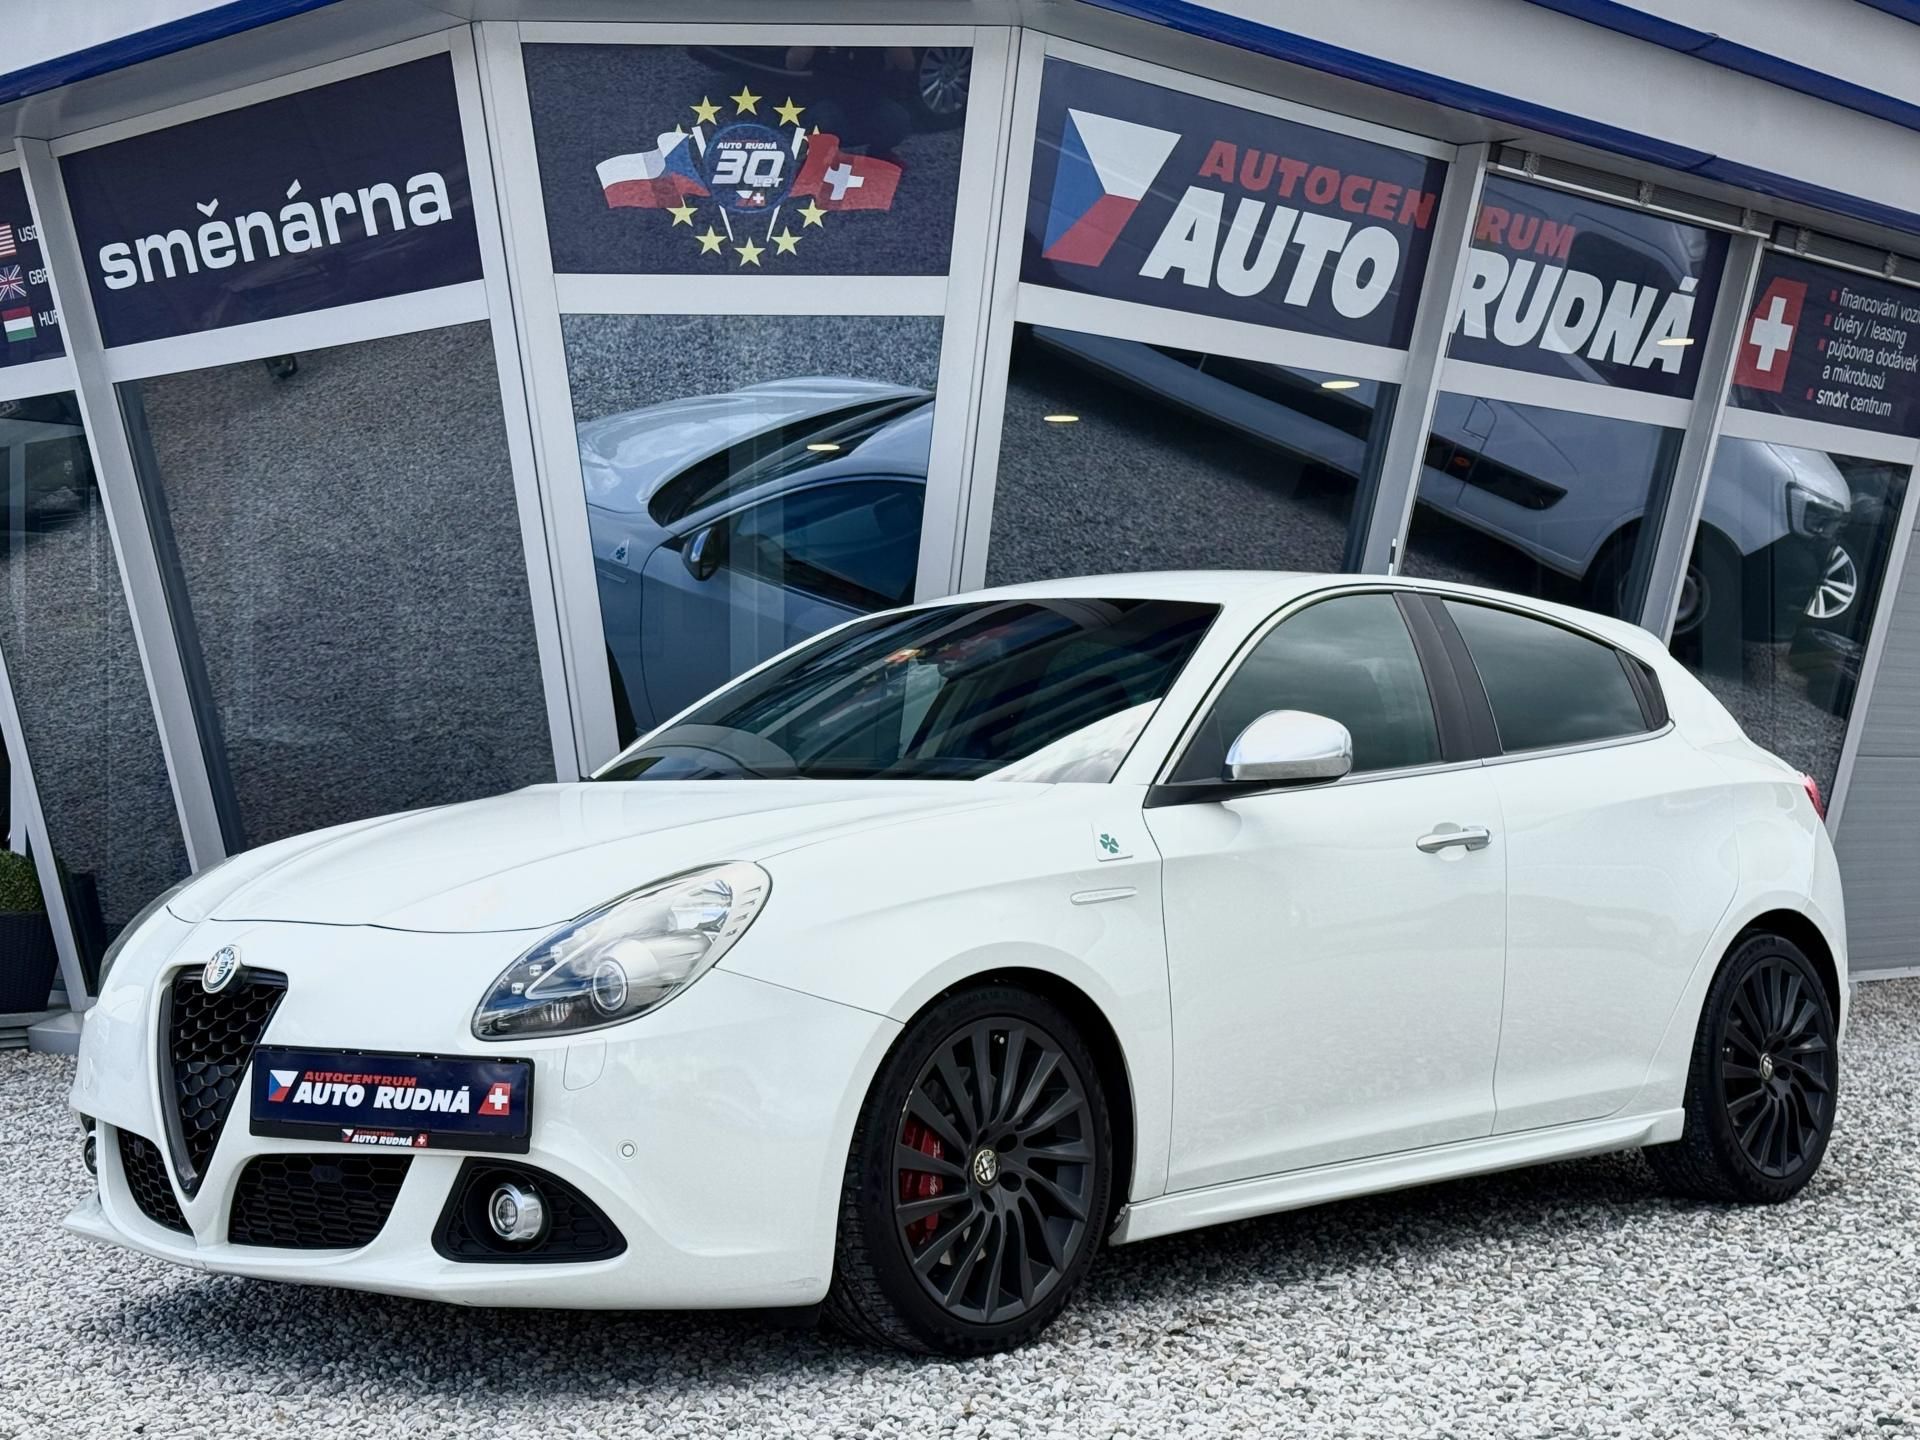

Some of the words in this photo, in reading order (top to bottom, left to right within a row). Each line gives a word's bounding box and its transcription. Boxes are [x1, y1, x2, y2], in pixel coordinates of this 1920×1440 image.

[717, 142, 742, 150] AUTO
[712, 150, 785, 185] 30
[99, 171, 453, 290] směnárna
[1138, 185, 1400, 319] AUTO
[1450, 247, 1699, 374] RUDNÁ
[1839, 287, 1900, 318] financování
[1833, 312, 1864, 340] úvěry
[1870, 320, 1907, 349] leasing
[1822, 364, 1831, 379] a
[1875, 347, 1919, 373] dodávek
[1850, 396, 1892, 416] centrum
[303, 1071, 417, 1087] AUTOCENTRUM
[292, 1081, 366, 1108] AUTO
[373, 1085, 470, 1114] RUDNÁ
[352, 1134, 378, 1143] AUTO
[378, 1135, 413, 1147] RUDNÁ
